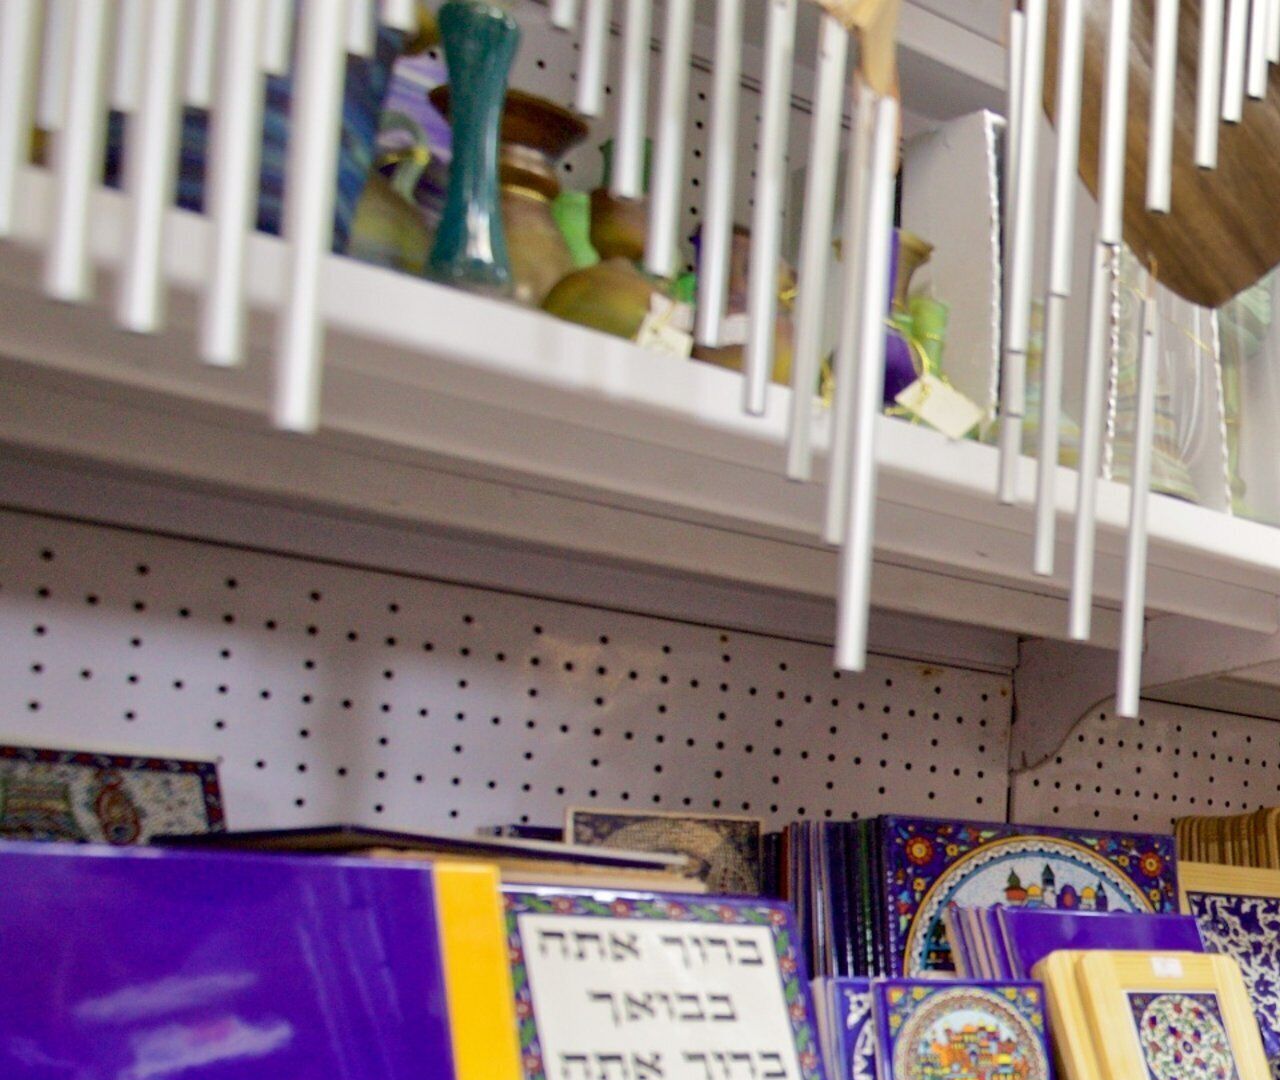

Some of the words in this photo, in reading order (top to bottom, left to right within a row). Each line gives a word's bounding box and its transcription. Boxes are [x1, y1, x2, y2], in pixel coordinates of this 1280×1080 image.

[540, 930, 640, 960] אתה
[659, 935, 764, 968] ברוך
[587, 990, 738, 1027] בבואך
